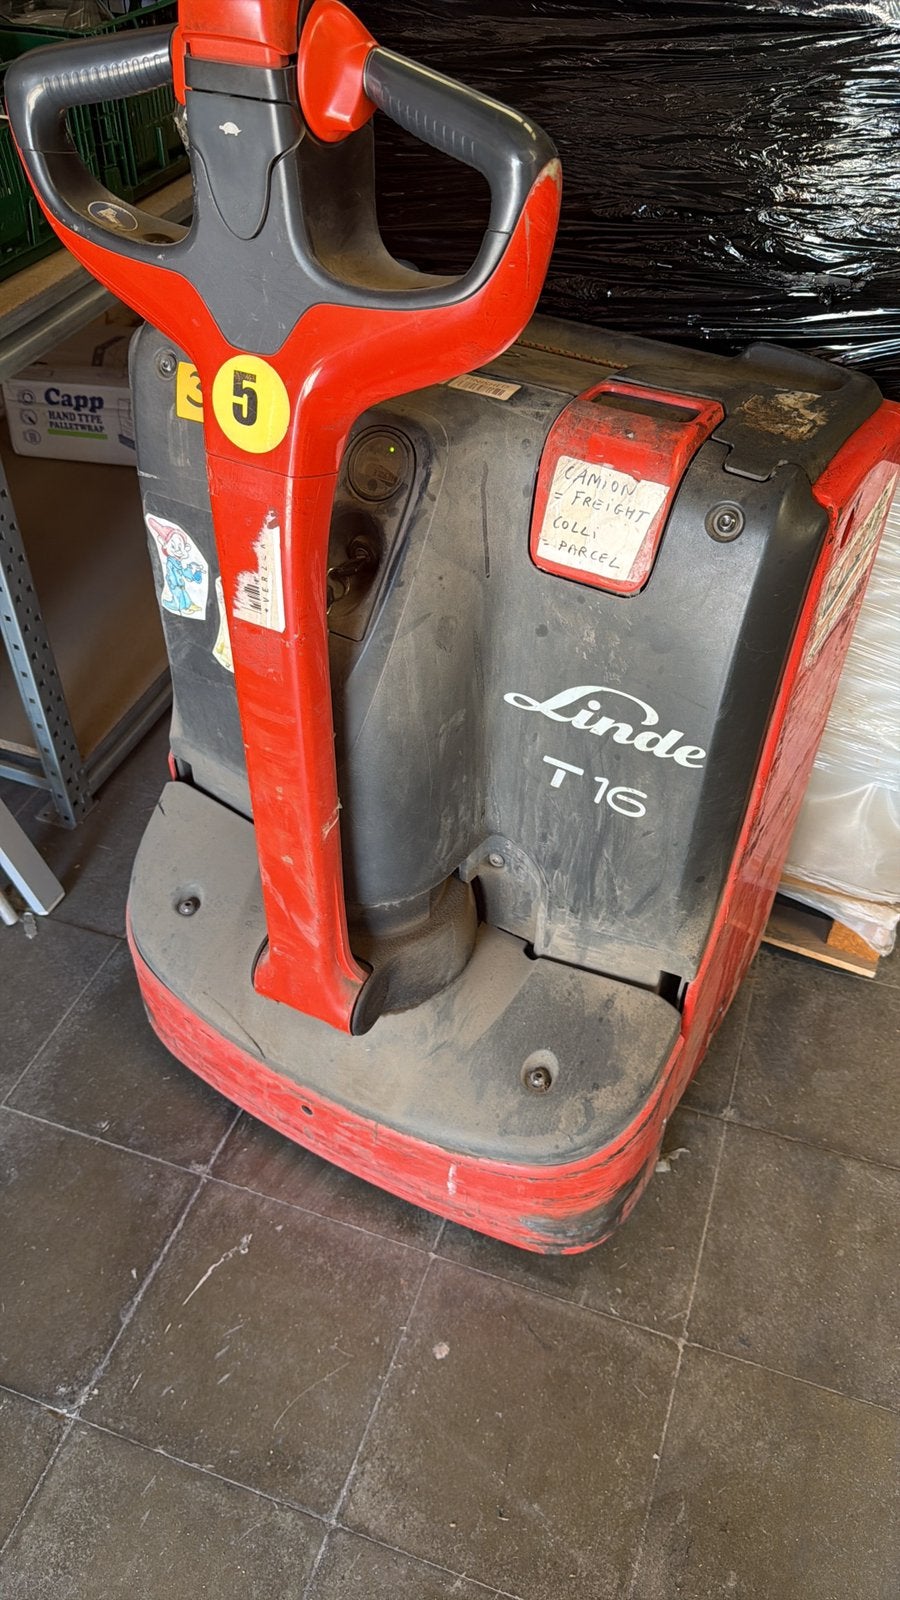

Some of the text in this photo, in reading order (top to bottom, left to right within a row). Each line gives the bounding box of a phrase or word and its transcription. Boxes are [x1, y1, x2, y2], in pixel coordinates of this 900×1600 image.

[44, 387, 105, 413] Capp
[232, 369, 258, 427] 5
[48, 410, 103, 424] HAND TYPE
[48, 421, 105, 433] PALLETWRAP
[558, 540, 621, 569] PARCEL
[503, 685, 707, 768] Linde
[542, 755, 648, 818] T 16
